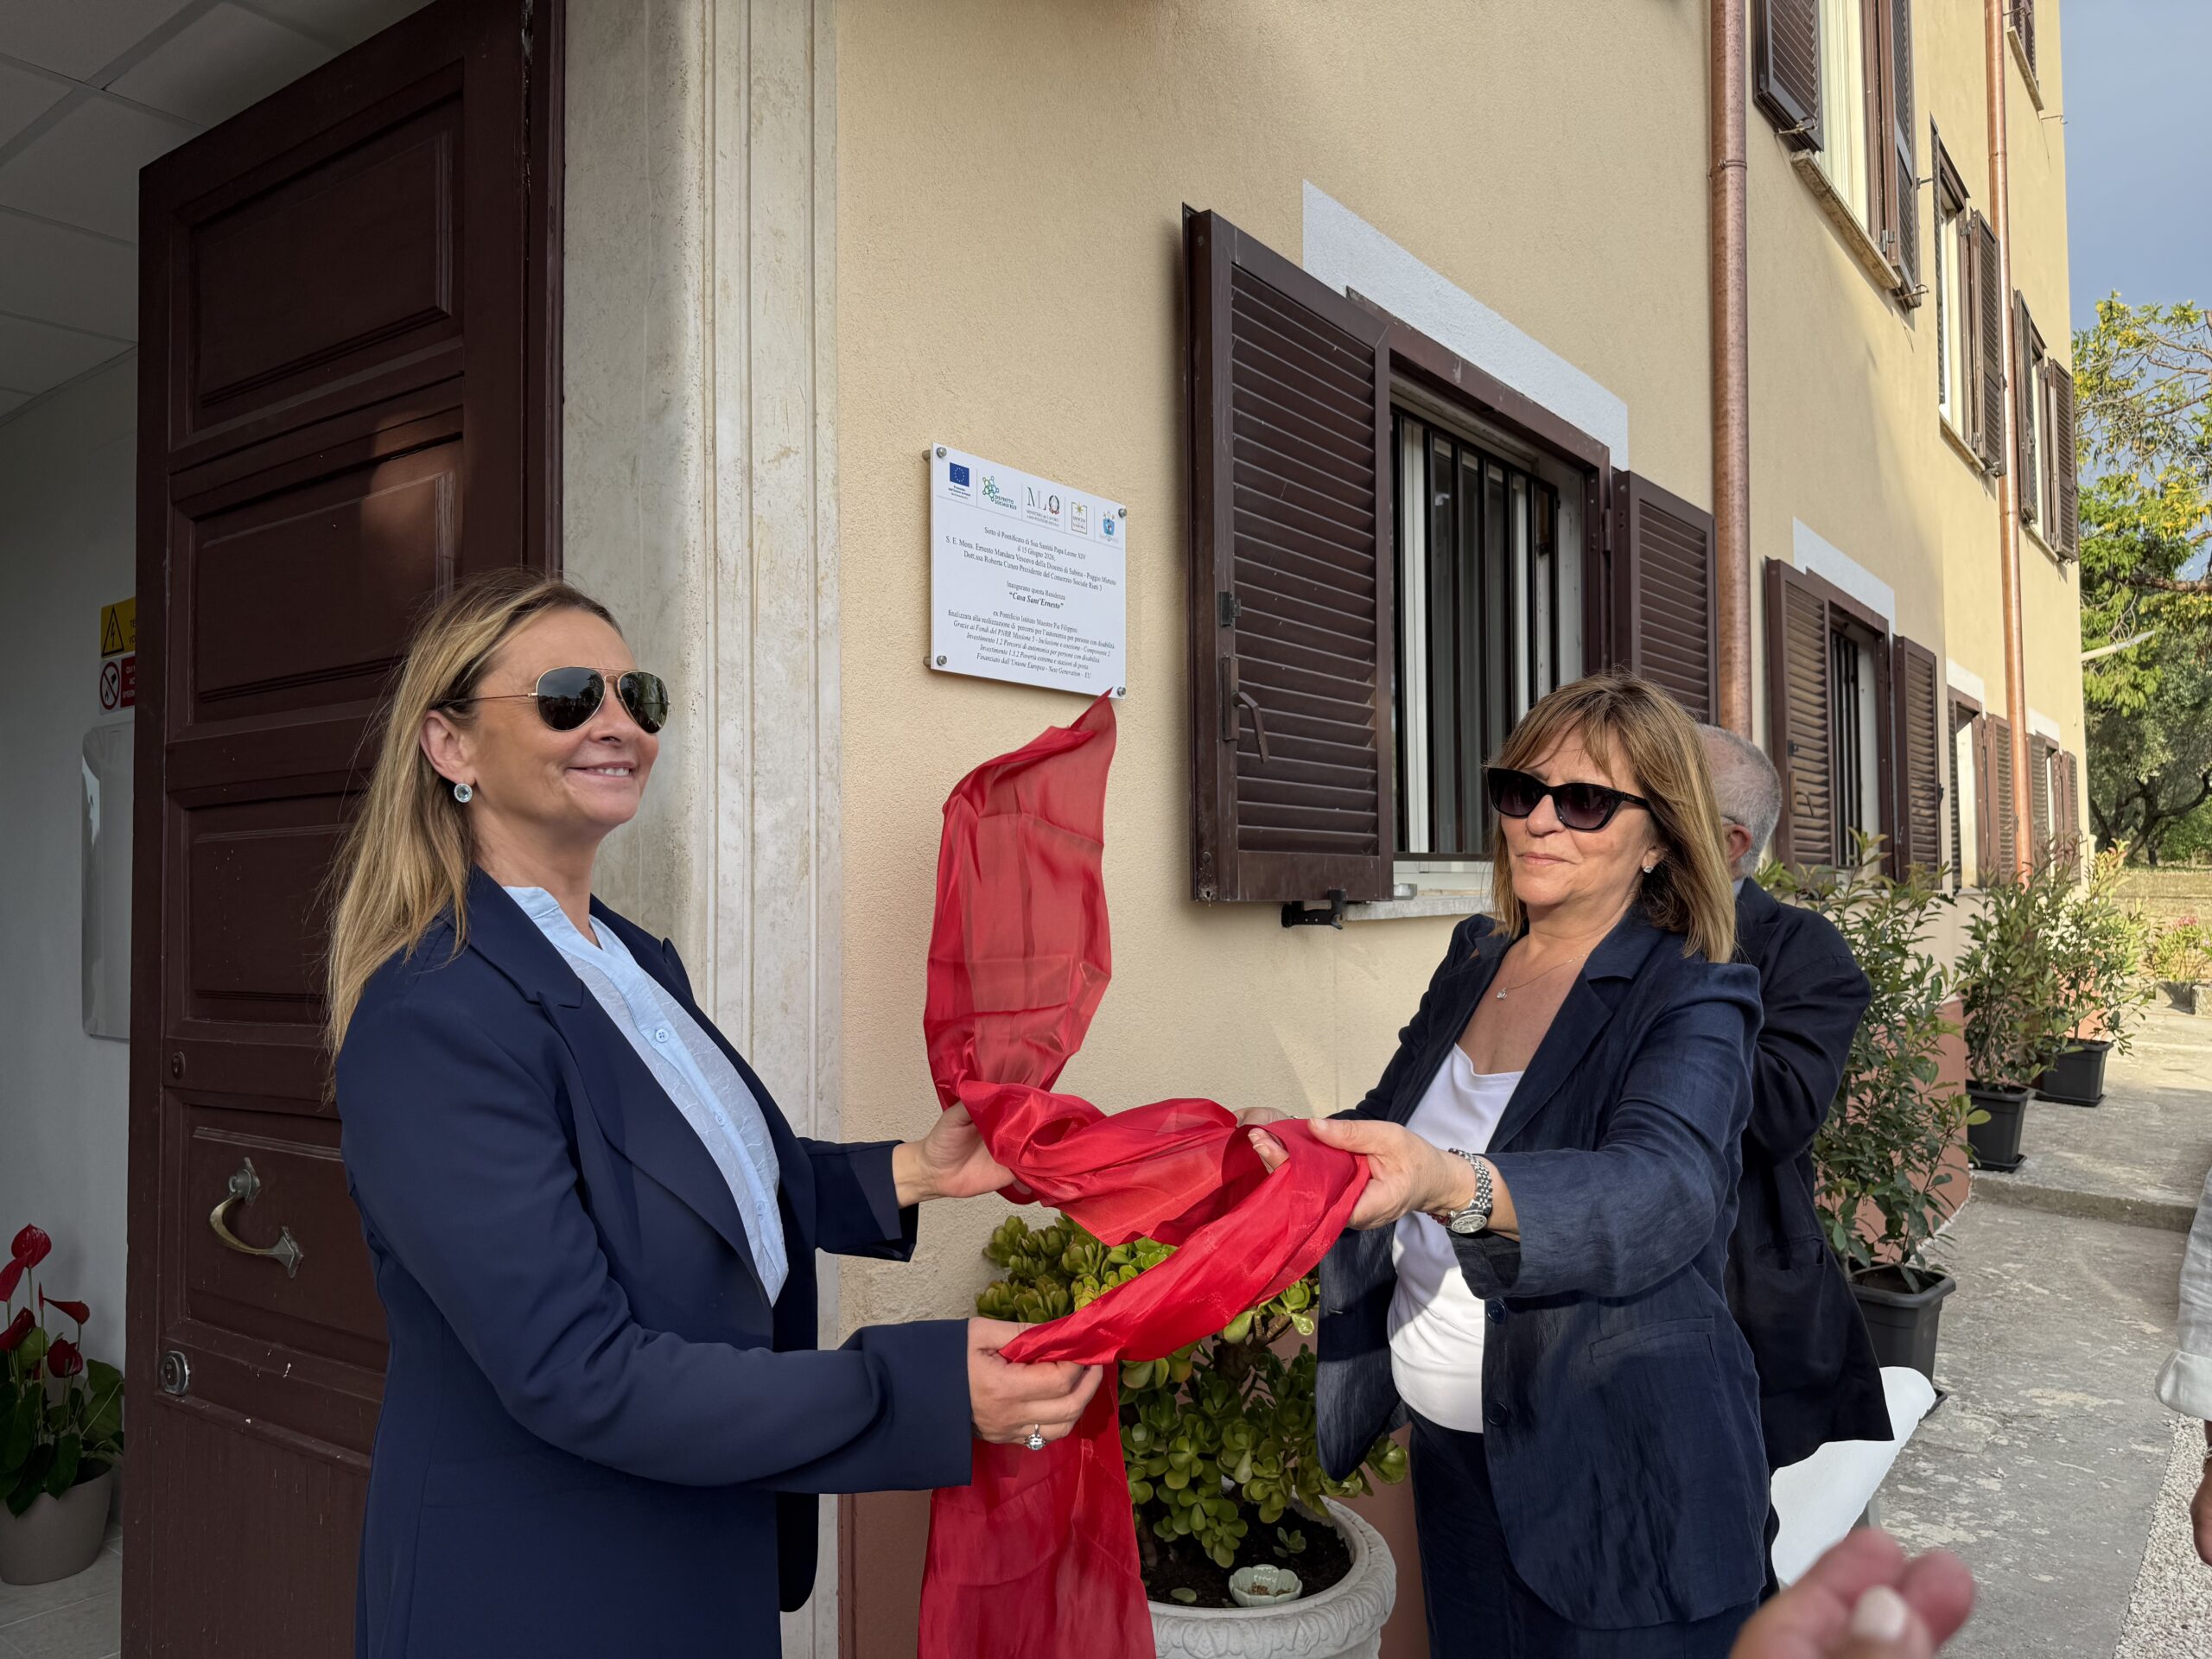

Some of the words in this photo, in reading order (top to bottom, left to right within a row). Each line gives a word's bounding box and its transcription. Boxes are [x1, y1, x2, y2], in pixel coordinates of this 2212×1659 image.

[985, 527, 996, 536] Sotto
[1001, 531, 1024, 543] Pontificato
[1054, 546, 1063, 556] Papa
[1065, 550, 1077, 558] Leone
[1028, 549, 1043, 559] Giugno
[976, 543, 993, 554] Ernesto
[995, 549, 1014, 560] Mandara
[1016, 554, 1034, 564] Vescovo
[1035, 559, 1046, 568] della
[1047, 563, 1063, 572] Diocesi
[1069, 568, 1083, 577] Sabina
[1087, 573, 1101, 583] Poggio
[985, 556, 1002, 566] Roberta
[1020, 565, 1042, 576] Presidente
[1051, 573, 1072, 583] Consorzio
[1073, 578, 1088, 588] Sociale
[1007, 581, 1030, 594] Inaugurano
[1032, 587, 1044, 597] questa
[1046, 590, 1065, 600] Residenza
[949, 610, 971, 620] finalizzata
[982, 617, 1010, 627] realizzazione
[1018, 624, 1033, 634] percorsi
[1075, 637, 1089, 645] persone
[1000, 611, 1020, 620] Pontificio
[1021, 615, 1035, 624] Istituto
[1037, 619, 1052, 627] Maestre
[954, 620, 969, 629] Grazie
[1013, 632, 1030, 641] Missione
[1039, 637, 1058, 646] Inclusione
[1064, 642, 1079, 651] coesione
[1084, 646, 1107, 657] Componente
[967, 632, 995, 643] Investimento
[1004, 639, 1021, 648] Percorsi
[1028, 644, 1049, 653] autonomia
[1058, 651, 1072, 659] persone
[980, 645, 1007, 655] Investimento
[977, 653, 1001, 663] Finanziato
[1027, 662, 1045, 671] Europea
[1058, 667, 1080, 677] Generation
